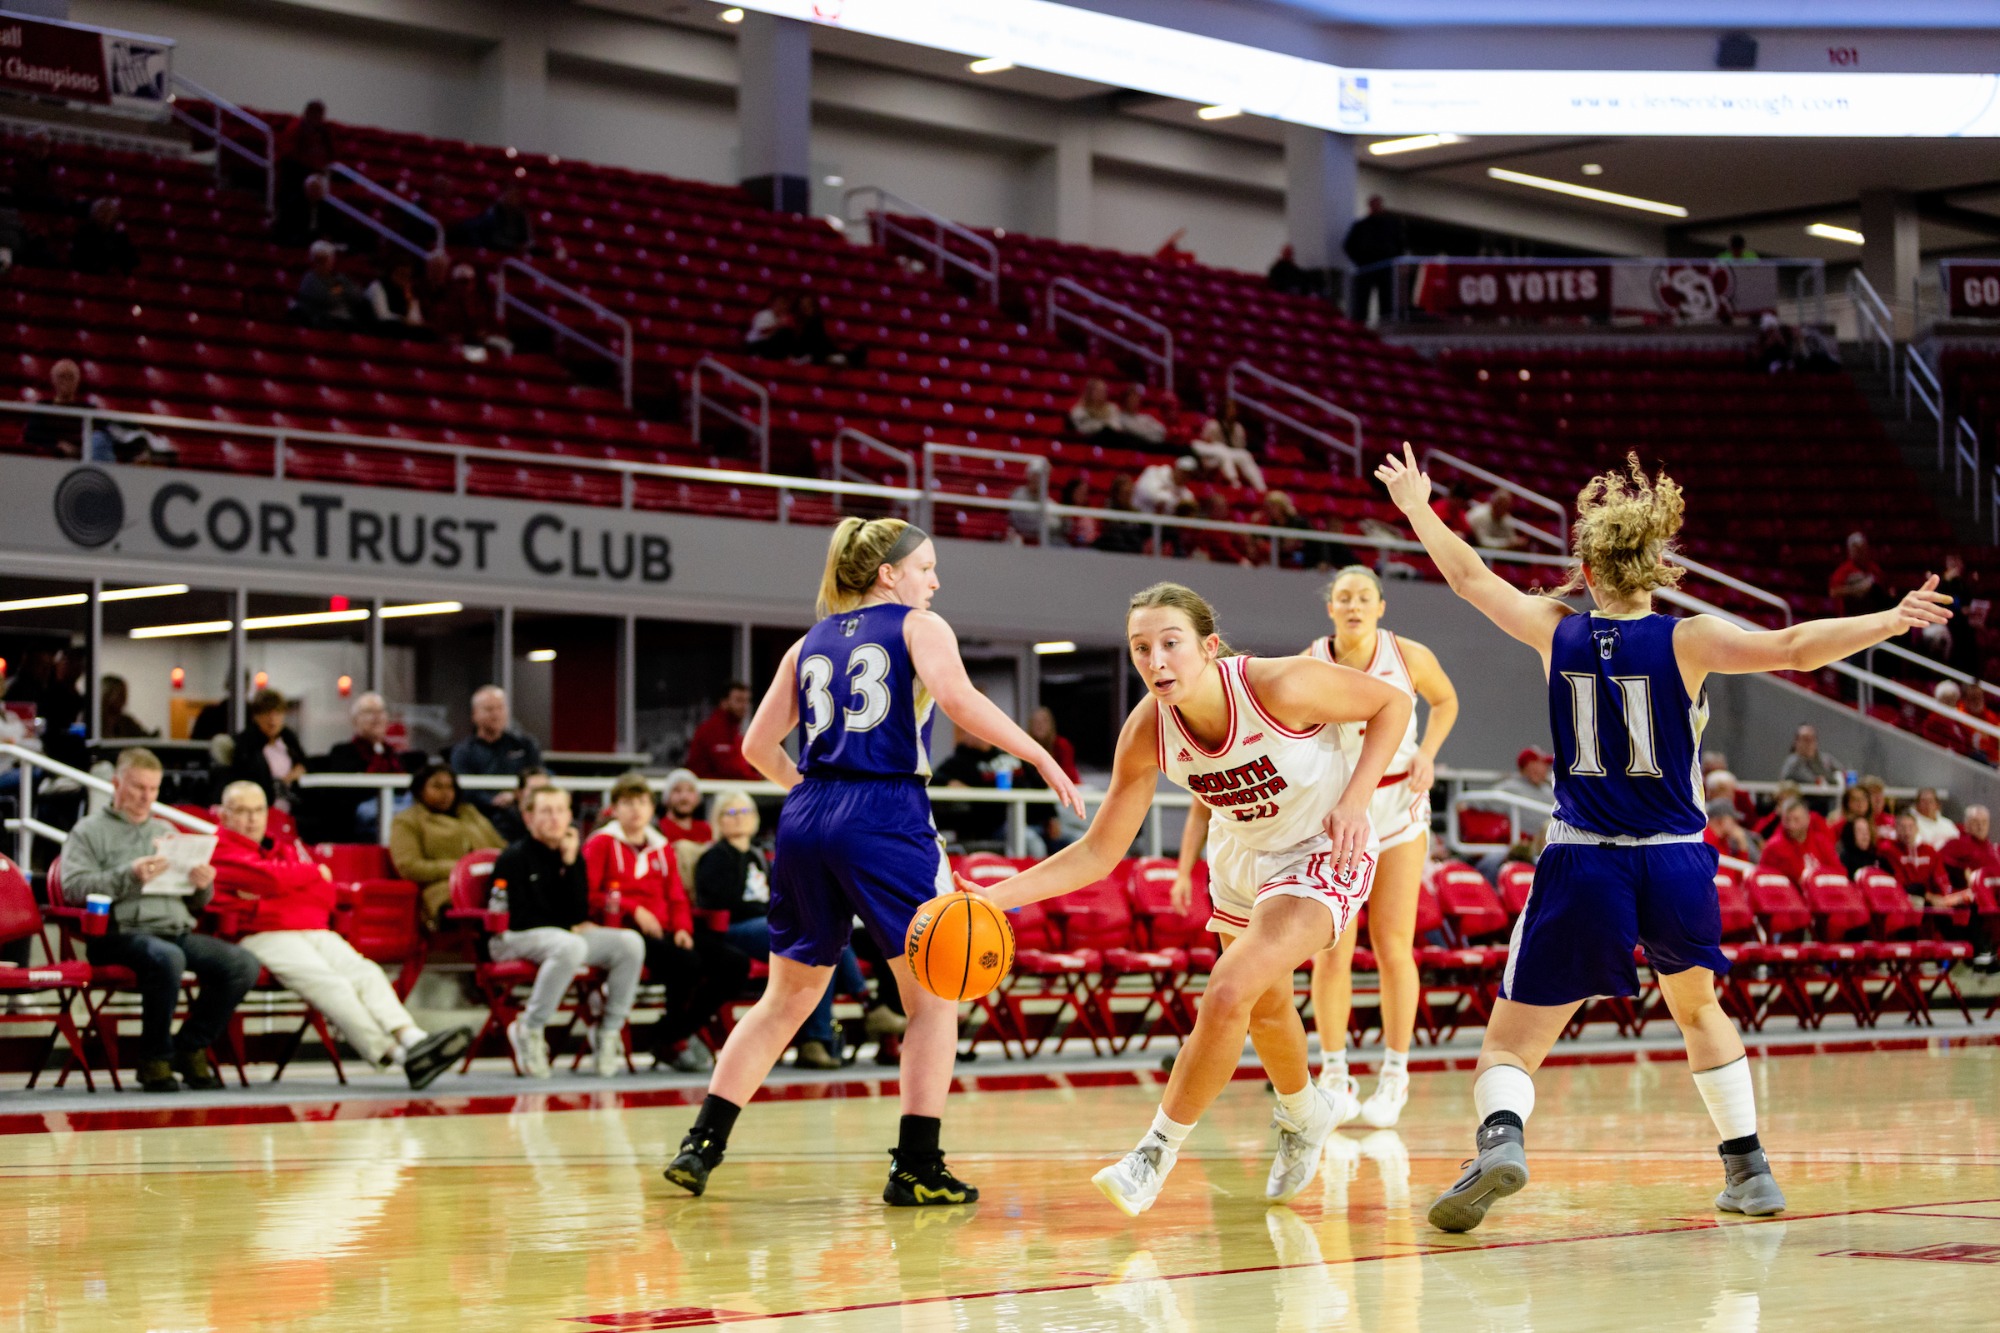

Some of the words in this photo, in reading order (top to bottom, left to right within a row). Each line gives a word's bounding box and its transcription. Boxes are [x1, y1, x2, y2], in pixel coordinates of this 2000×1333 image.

[0, 26, 22, 48] all
[1828, 47, 1858, 65] 101
[5, 56, 100, 93] Champions
[1459, 274, 1498, 304] GO
[1506, 269, 1598, 304] YOTES
[1963, 276, 2000, 307] GO
[800, 643, 891, 746] 33
[1560, 671, 1663, 778] 11
[1187, 754, 1278, 794] SOUTH
[1200, 775, 1288, 808] DAKOTA
